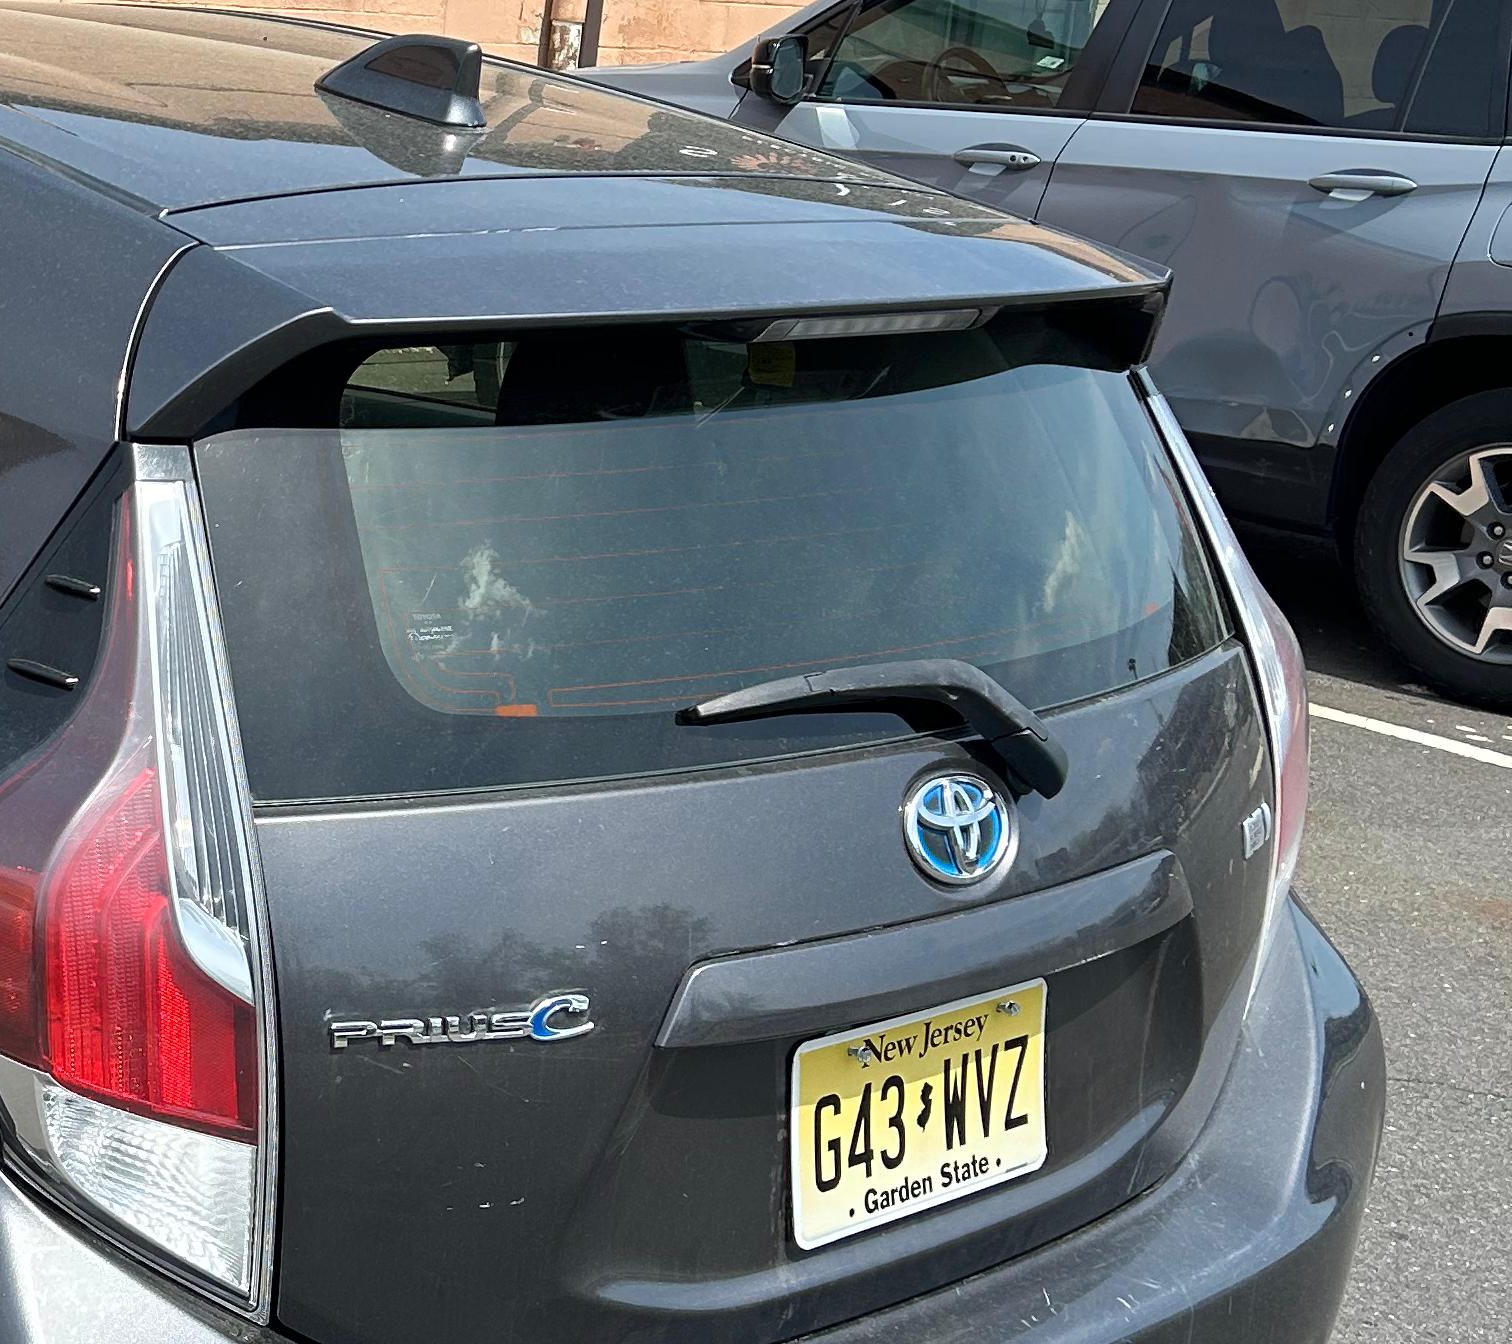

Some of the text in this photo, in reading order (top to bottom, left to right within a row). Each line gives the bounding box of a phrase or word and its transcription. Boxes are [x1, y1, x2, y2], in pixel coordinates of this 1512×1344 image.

[330, 1012, 531, 1049] PRIUS
[862, 1014, 988, 1068] New Jersey
[864, 1154, 989, 1214] Garden State
